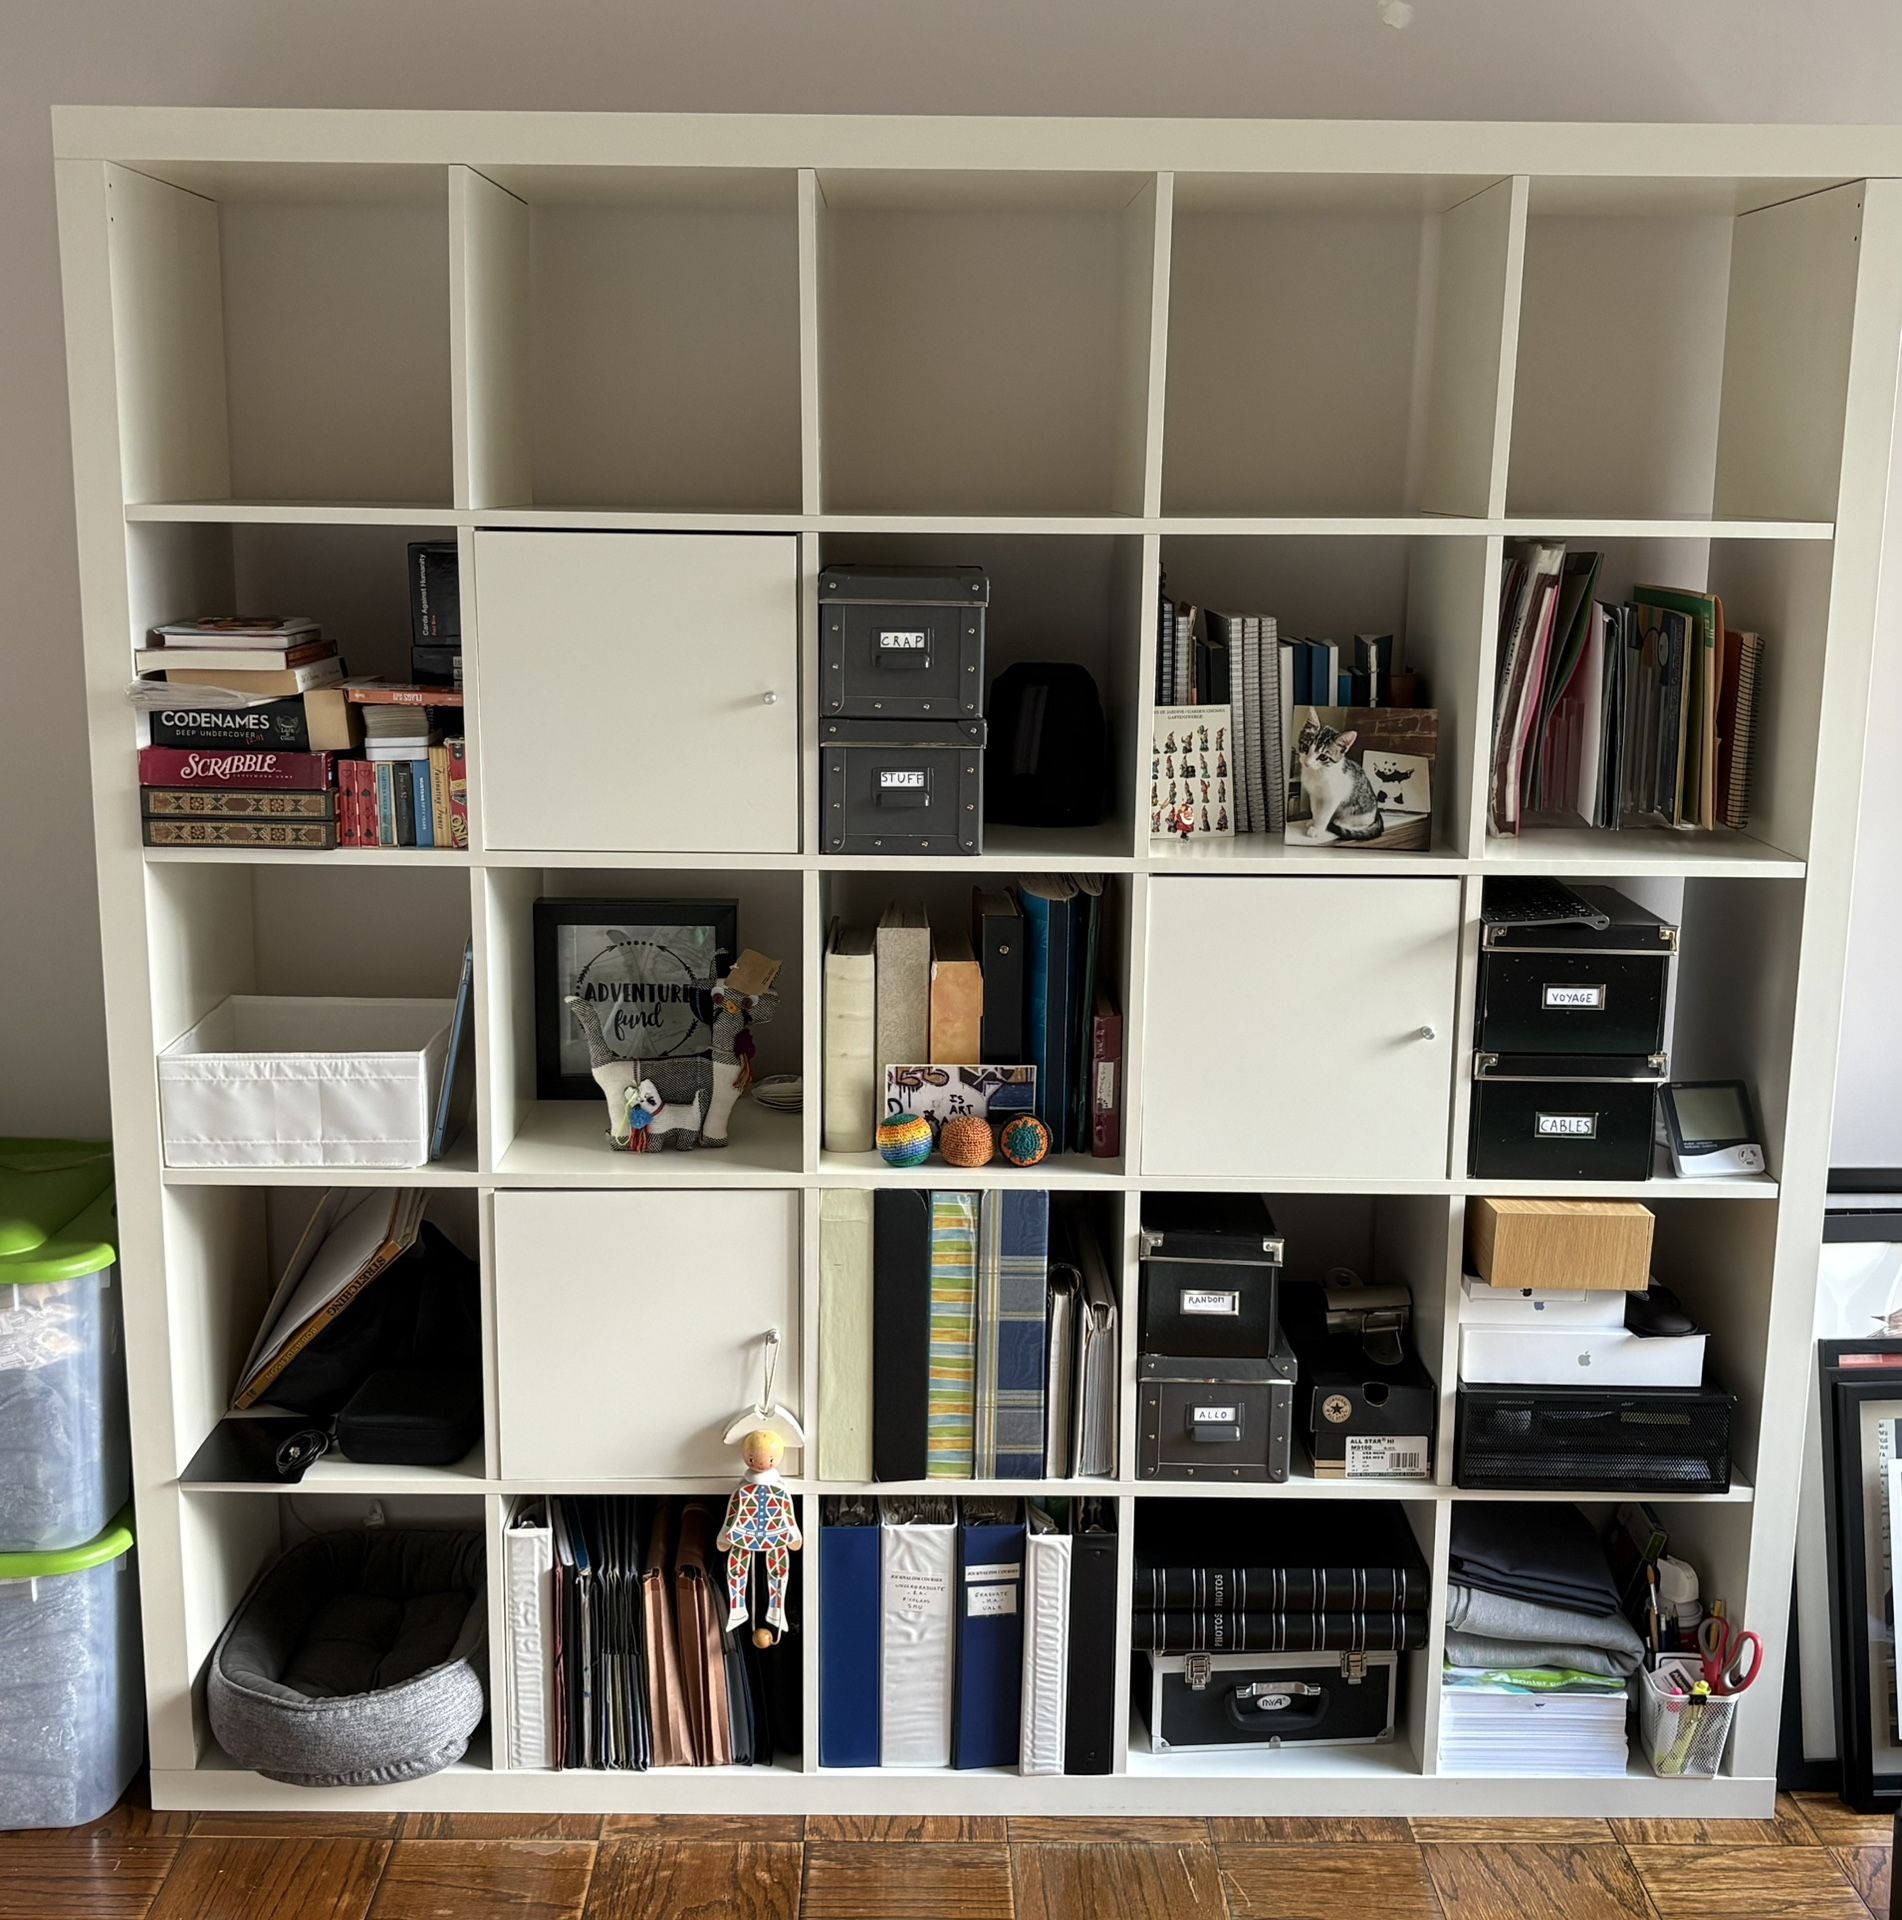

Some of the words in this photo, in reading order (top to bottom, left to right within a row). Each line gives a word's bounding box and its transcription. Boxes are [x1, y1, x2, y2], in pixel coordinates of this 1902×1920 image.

[418, 554, 427, 587] Humanity
[420, 588, 429, 614] Against
[881, 634, 924, 648] CRAP
[161, 710, 270, 729] CODENAMES
[175, 729, 197, 737] DEEP
[200, 730, 256, 738] UNDERCOVER
[180, 753, 277, 780] SCRABBLE
[881, 772, 924, 785] STUFF
[584, 983, 693, 1003] ADVENTURE
[1551, 992, 1594, 1004] VOYAGE
[614, 1002, 664, 1041] fund
[950, 1094, 965, 1104] IS
[950, 1104, 974, 1116] ART
[1540, 1119, 1590, 1133] CABLES
[326, 1255, 386, 1317] STRETCHING
[1188, 1295, 1226, 1305] RANDOM
[1198, 1411, 1228, 1420] ALLO
[1214, 1574, 1223, 1607] PHOTOS
[1214, 1613, 1223, 1647] PHOTOS
